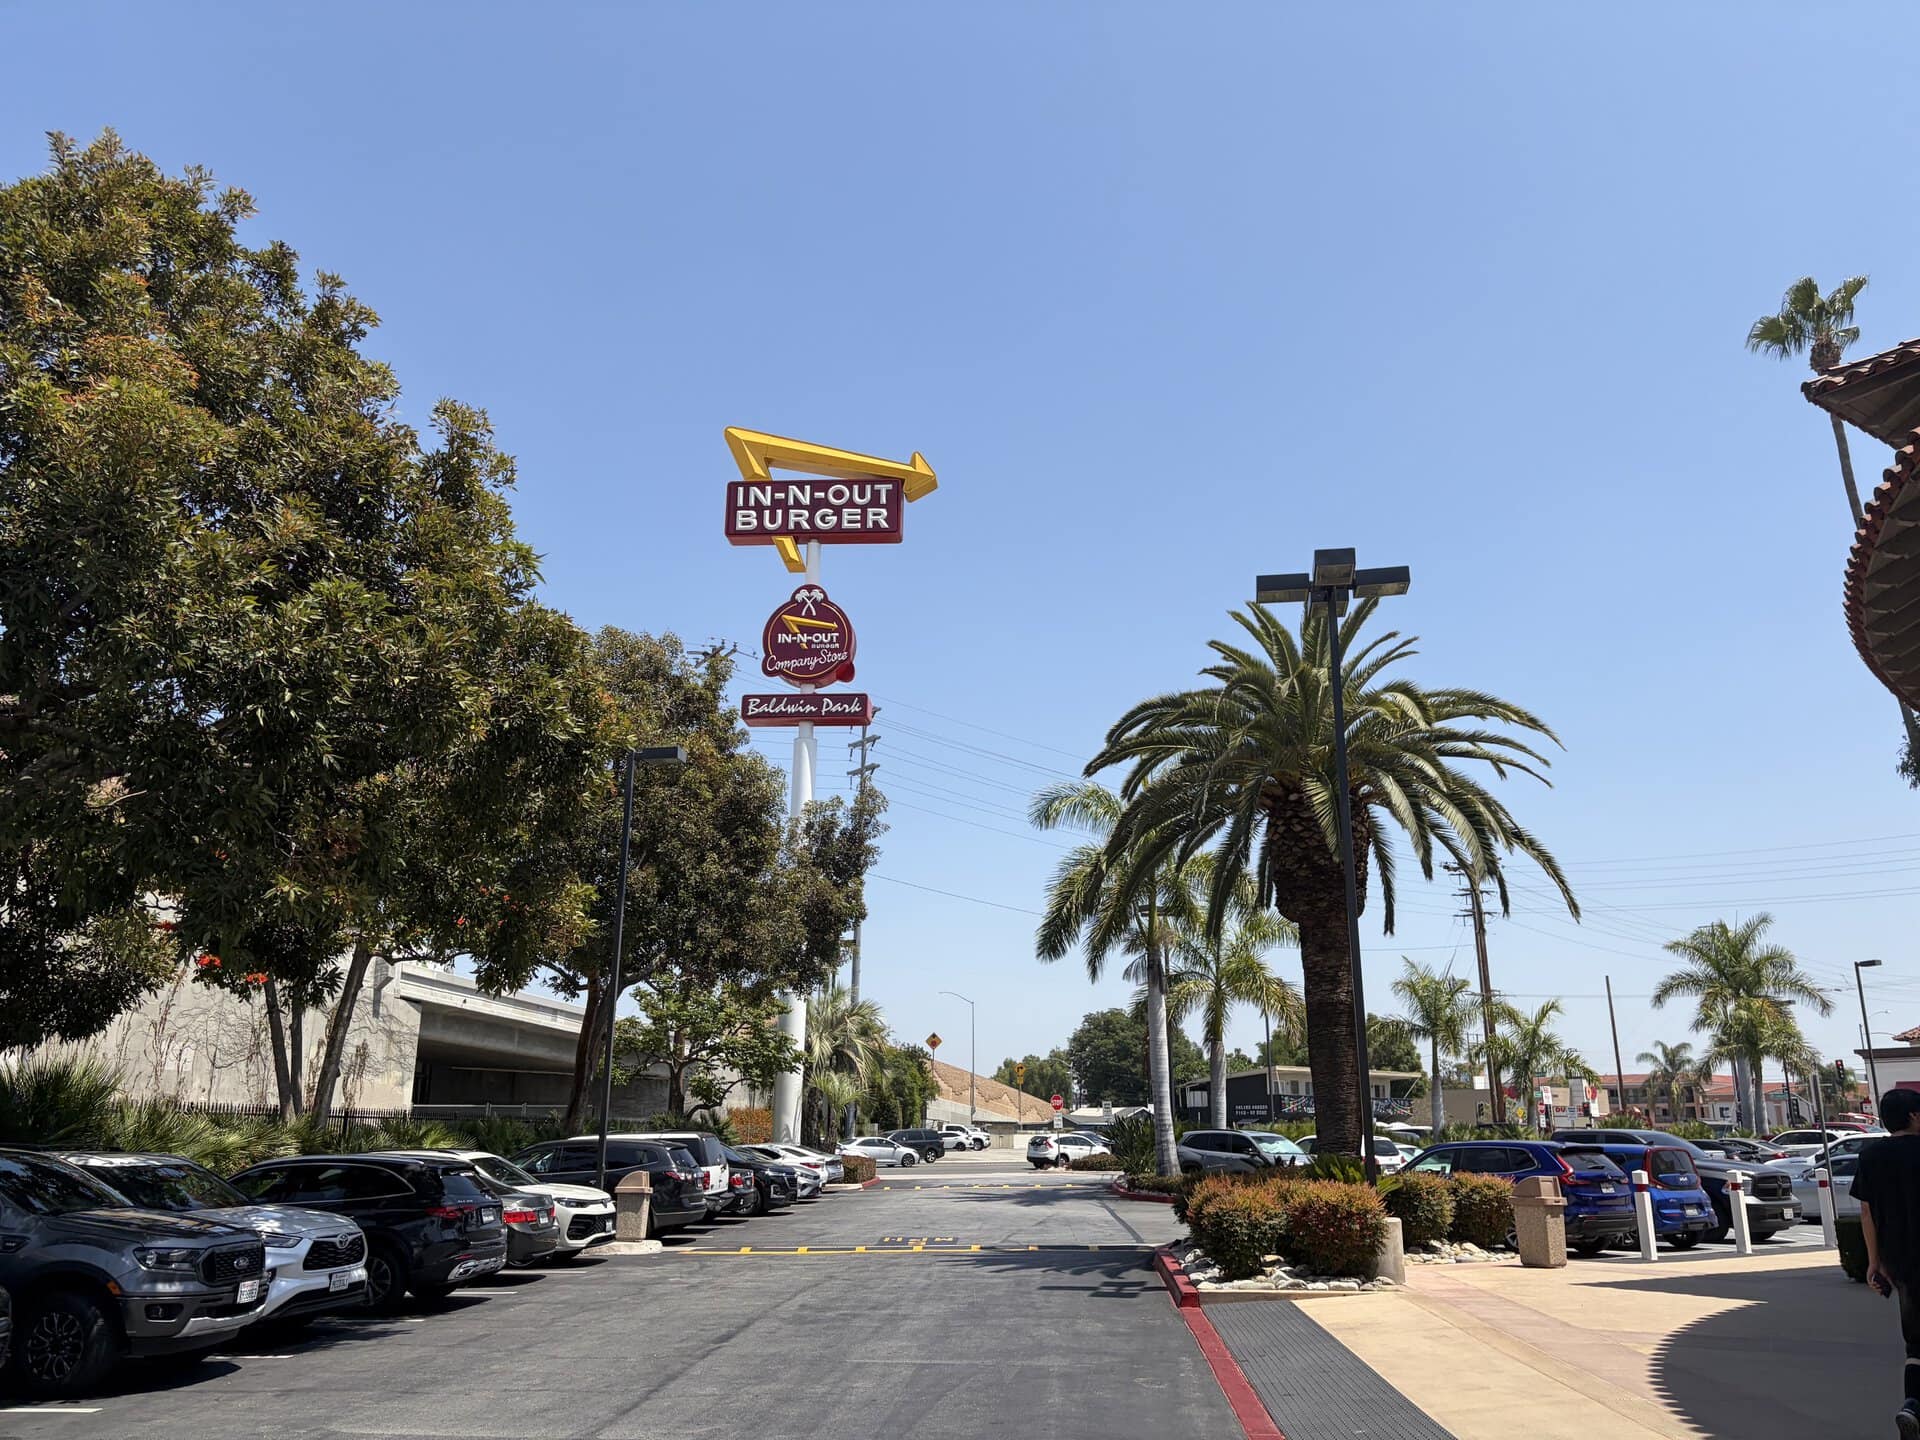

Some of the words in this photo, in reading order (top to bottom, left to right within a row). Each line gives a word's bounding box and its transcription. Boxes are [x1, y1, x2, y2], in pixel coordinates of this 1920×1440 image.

[737, 484, 893, 507] IN-N-OUT
[735, 508, 889, 531] BURGER
[777, 632, 839, 644] IN-N-OUT
[766, 654, 818, 671] Company
[818, 648, 849, 664] Store
[747, 697, 818, 716] Baldwin
[821, 697, 863, 716] Park
